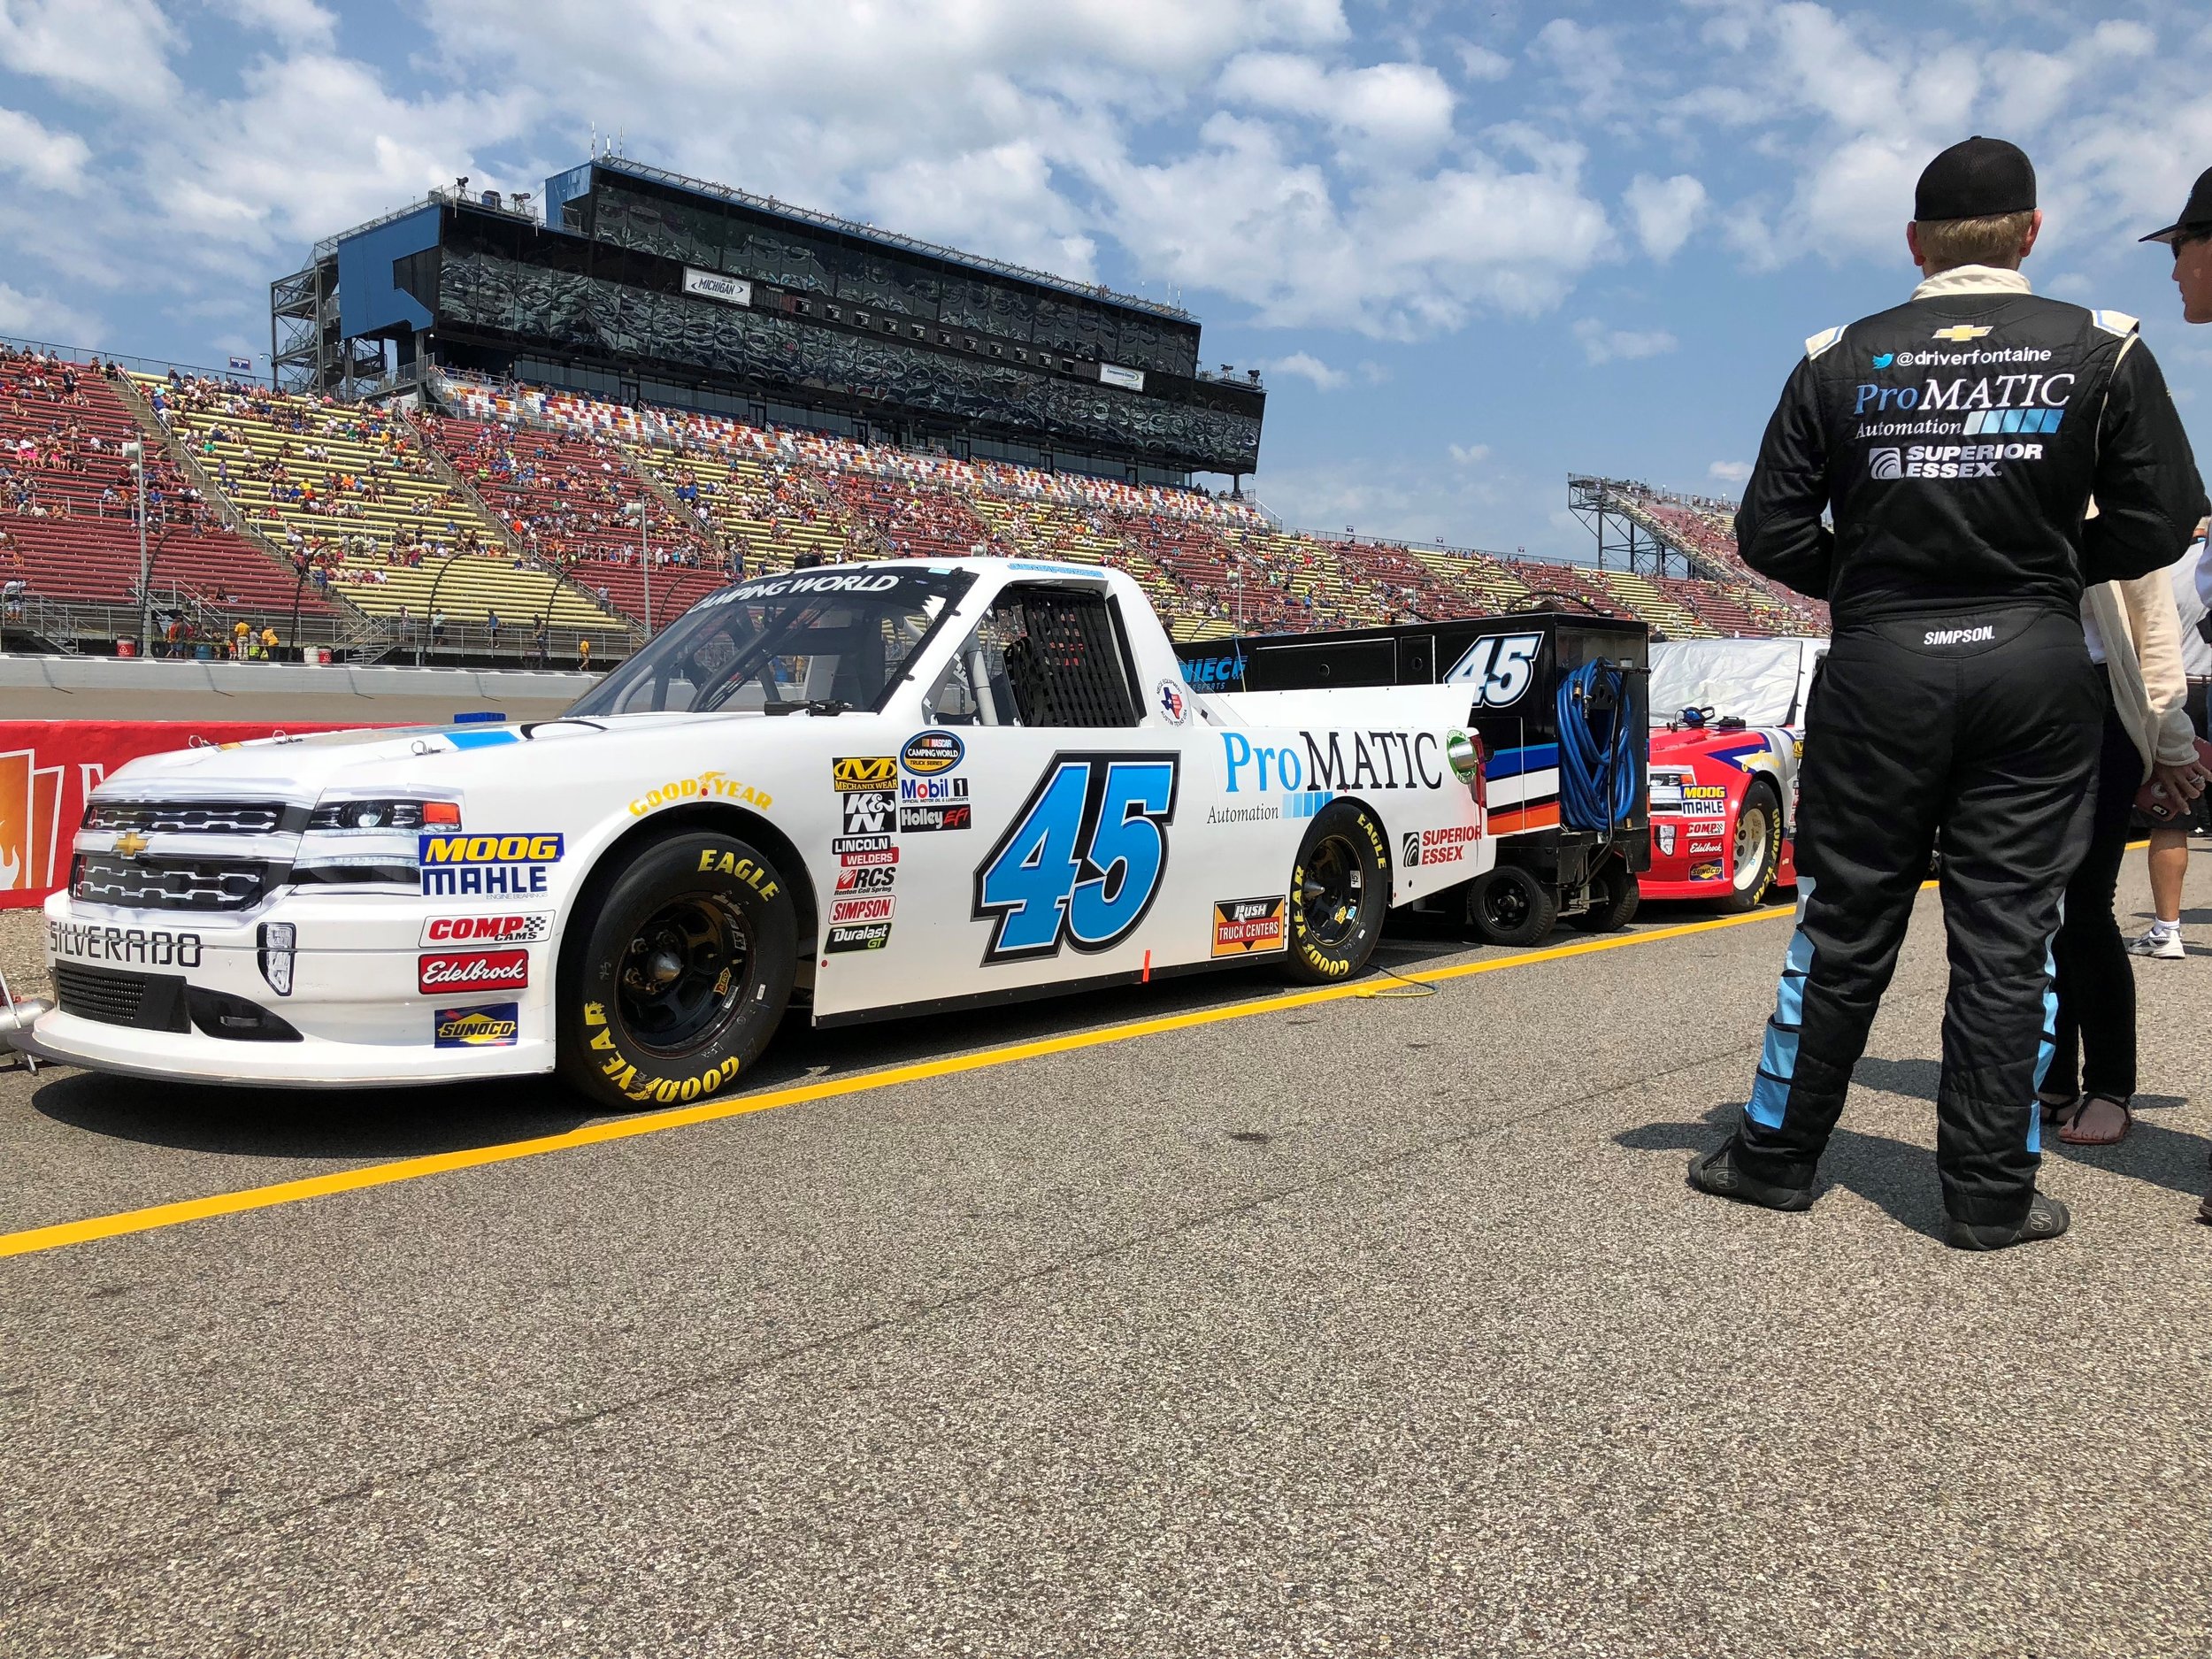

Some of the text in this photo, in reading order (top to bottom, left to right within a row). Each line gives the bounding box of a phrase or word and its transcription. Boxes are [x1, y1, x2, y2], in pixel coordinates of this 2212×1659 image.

[698, 278, 735, 296] MICHIGAN
[1896, 346, 2052, 367] @driverfontaine
[1853, 373, 2075, 415] ProMATIC
[1855, 419, 1962, 439] Automation
[1906, 443, 2043, 461] SUPERIOR
[1906, 462, 1998, 478] ESSEX
[788, 575, 899, 594] WORLD
[1924, 625, 1993, 645] SIMPSON
[1445, 633, 1542, 707] 45
[931, 739, 952, 748] NASCAR
[1219, 731, 1442, 792] ProMATIC
[834, 779, 898, 791] MECHANIX WEAR
[902, 778, 949, 798] Mobil
[1683, 786, 1725, 799] MOOG
[1207, 803, 1279, 824] Automation
[1683, 801, 1724, 814] MAHLE
[901, 808, 943, 830] Holley
[1688, 824, 1717, 834] COMP
[834, 838, 888, 853] LINCOLN
[1356, 813, 1387, 870] EAGLE
[1422, 825, 1482, 847] SUPERIOR
[425, 836, 558, 863] MOOG
[1421, 845, 1463, 865] ESSEX
[1689, 841, 1723, 853] Edelbrock
[847, 852, 894, 865] WELDERS
[974, 754, 1178, 962] 45
[422, 866, 548, 895] MAHLE
[697, 849, 780, 902] EAGLE
[853, 866, 896, 888] RCS
[833, 898, 891, 921] SIMPSON
[428, 916, 524, 940] COMP
[494, 931, 537, 941] CAMS
[833, 924, 887, 942] Duralast
[1218, 921, 1279, 941] TRUCK CENTERS
[50, 920, 202, 968] SILVERADO
[867, 938, 885, 949] GT
[422, 958, 526, 984] Edelbrock
[442, 1022, 513, 1036] SUNOCO
